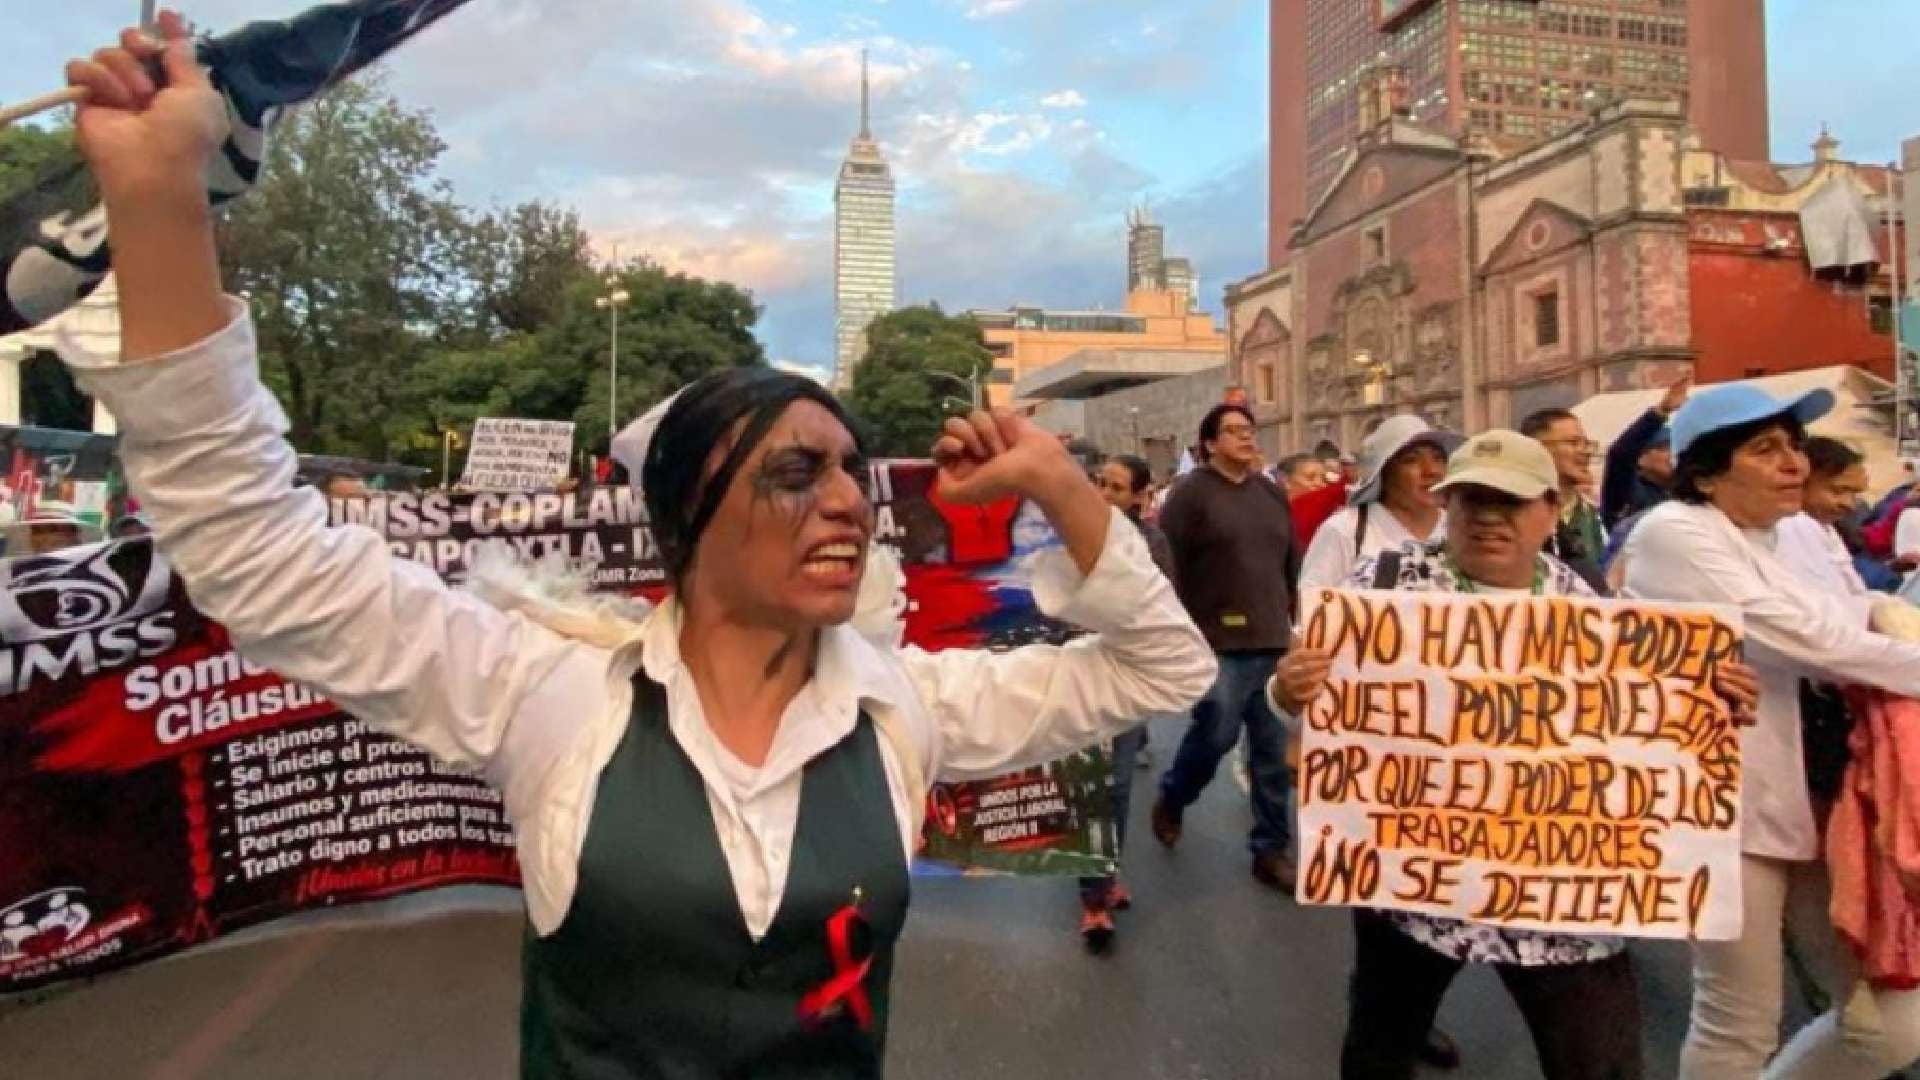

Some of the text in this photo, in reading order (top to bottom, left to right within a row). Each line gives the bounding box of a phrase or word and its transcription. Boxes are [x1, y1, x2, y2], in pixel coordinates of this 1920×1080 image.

[0, 610, 176, 694] IMSS
[1420, 600, 1514, 672] HAY
[1517, 600, 1604, 674] MAS
[156, 681, 330, 743] Cláusu
[1449, 676, 1570, 750] PODER
[227, 725, 338, 763] Exigimos
[231, 766, 263, 787] Se
[269, 748, 335, 777] inicie
[339, 740, 362, 762] el
[232, 775, 318, 810] Salario
[322, 771, 338, 791] y
[343, 760, 426, 785] centros
[235, 796, 336, 834] Insumos
[341, 794, 353, 814] y
[360, 778, 503, 807] medicamentos
[1502, 755, 1622, 820] PODER
[239, 812, 345, 857] Personal
[348, 802, 456, 832] suficiente
[240, 850, 304, 881] Trato
[309, 837, 372, 862] digno
[377, 834, 391, 851] a
[397, 821, 457, 847] todos
[459, 812, 487, 841] los
[1366, 810, 1664, 870] TRABAJADORES
[1391, 855, 1465, 906] SE
